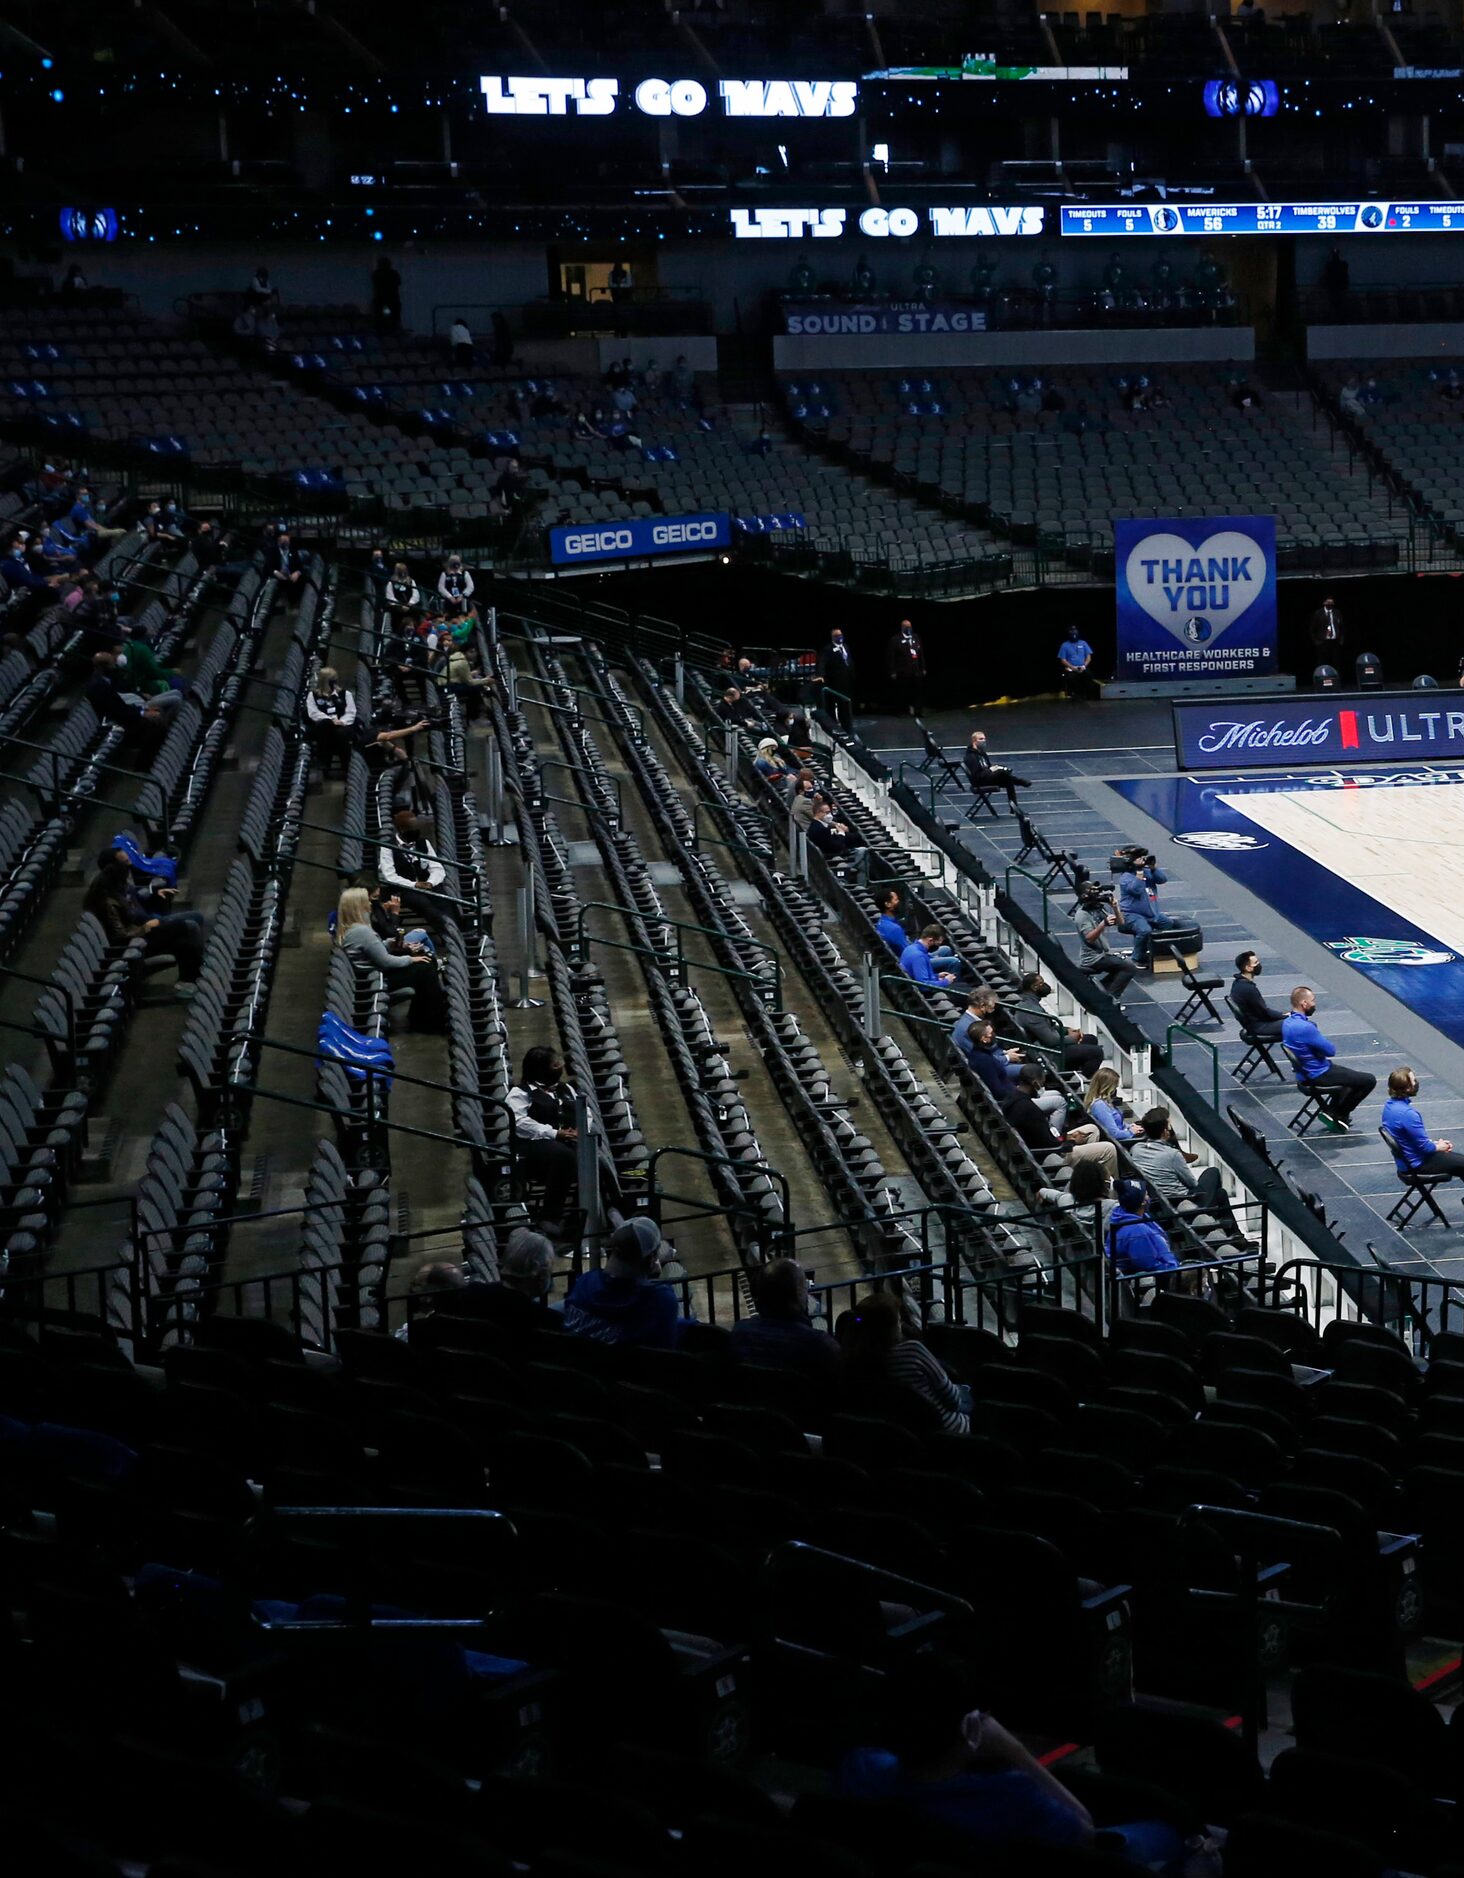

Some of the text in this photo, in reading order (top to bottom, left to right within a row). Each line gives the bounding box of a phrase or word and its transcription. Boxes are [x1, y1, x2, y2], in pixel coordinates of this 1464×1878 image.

[480, 76, 858, 117] LET'S GO MAVS
[730, 206, 1044, 237] LET'S GO MAVS
[1068, 210, 1107, 219] TIMEOUTS
[1117, 209, 1142, 218] FOULS
[1187, 208, 1237, 217] MAVERICKS
[1256, 205, 1283, 220] 5:17
[1293, 206, 1356, 216] TIMBERWOLVES
[1395, 206, 1419, 215] FOULS
[1083, 214, 1451, 232] 5 5 56 QTR 2 39 2 5
[890, 302, 927, 312] ULTRA
[786, 312, 987, 335] SOUND STAGE
[565, 521, 718, 554] GEICO GEICO
[1140, 557, 1253, 584] THANK
[1163, 585, 1229, 611] YOU
[1126, 647, 1270, 662] HEALTHCARE WORKERS &
[1143, 660, 1255, 673] FIRST RESPONDERS
[1199, 718, 1333, 753] Michelob
